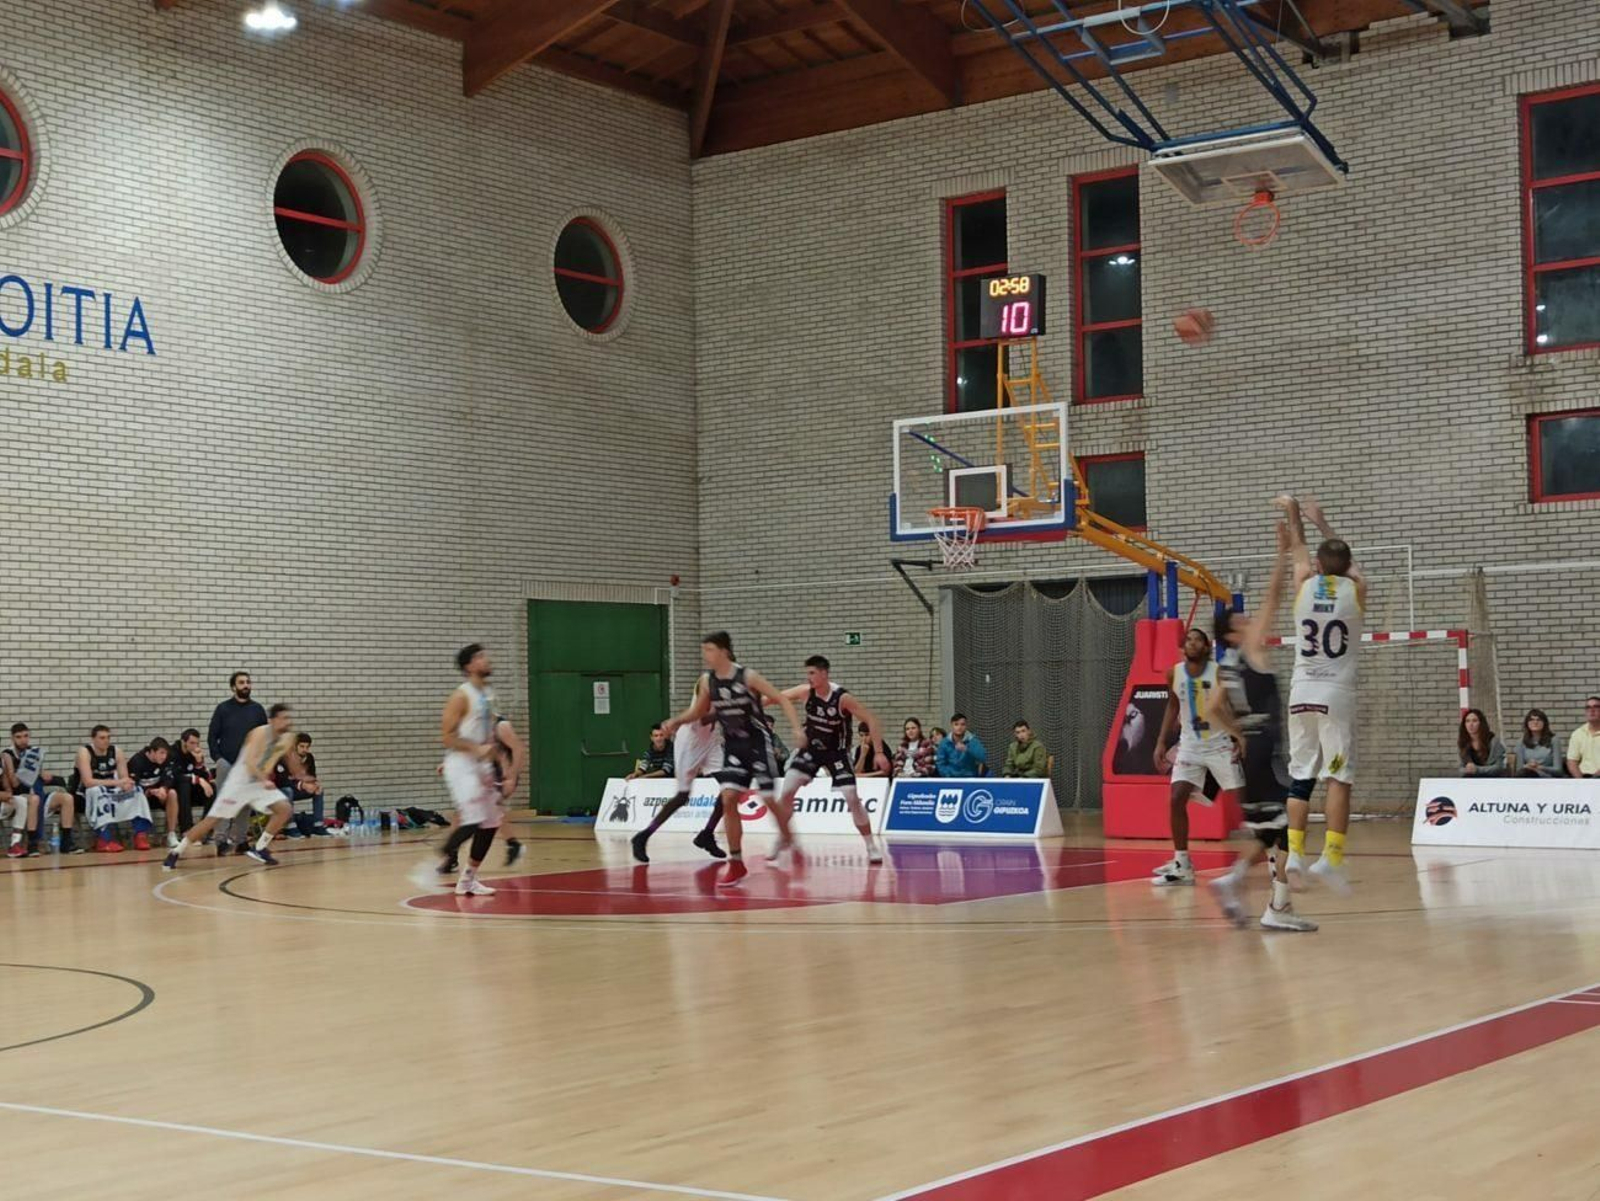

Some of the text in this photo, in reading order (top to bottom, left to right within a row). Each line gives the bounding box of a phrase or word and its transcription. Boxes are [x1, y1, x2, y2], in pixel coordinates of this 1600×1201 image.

[989, 276, 1030, 297] 02:58
[0, 275, 156, 355] OITIA
[1001, 302, 1030, 333] 10
[1301, 619, 1349, 659] 30
[1469, 802, 1591, 814] ALTUNA Y URIA
[1503, 814, 1590, 826] Construcciones
